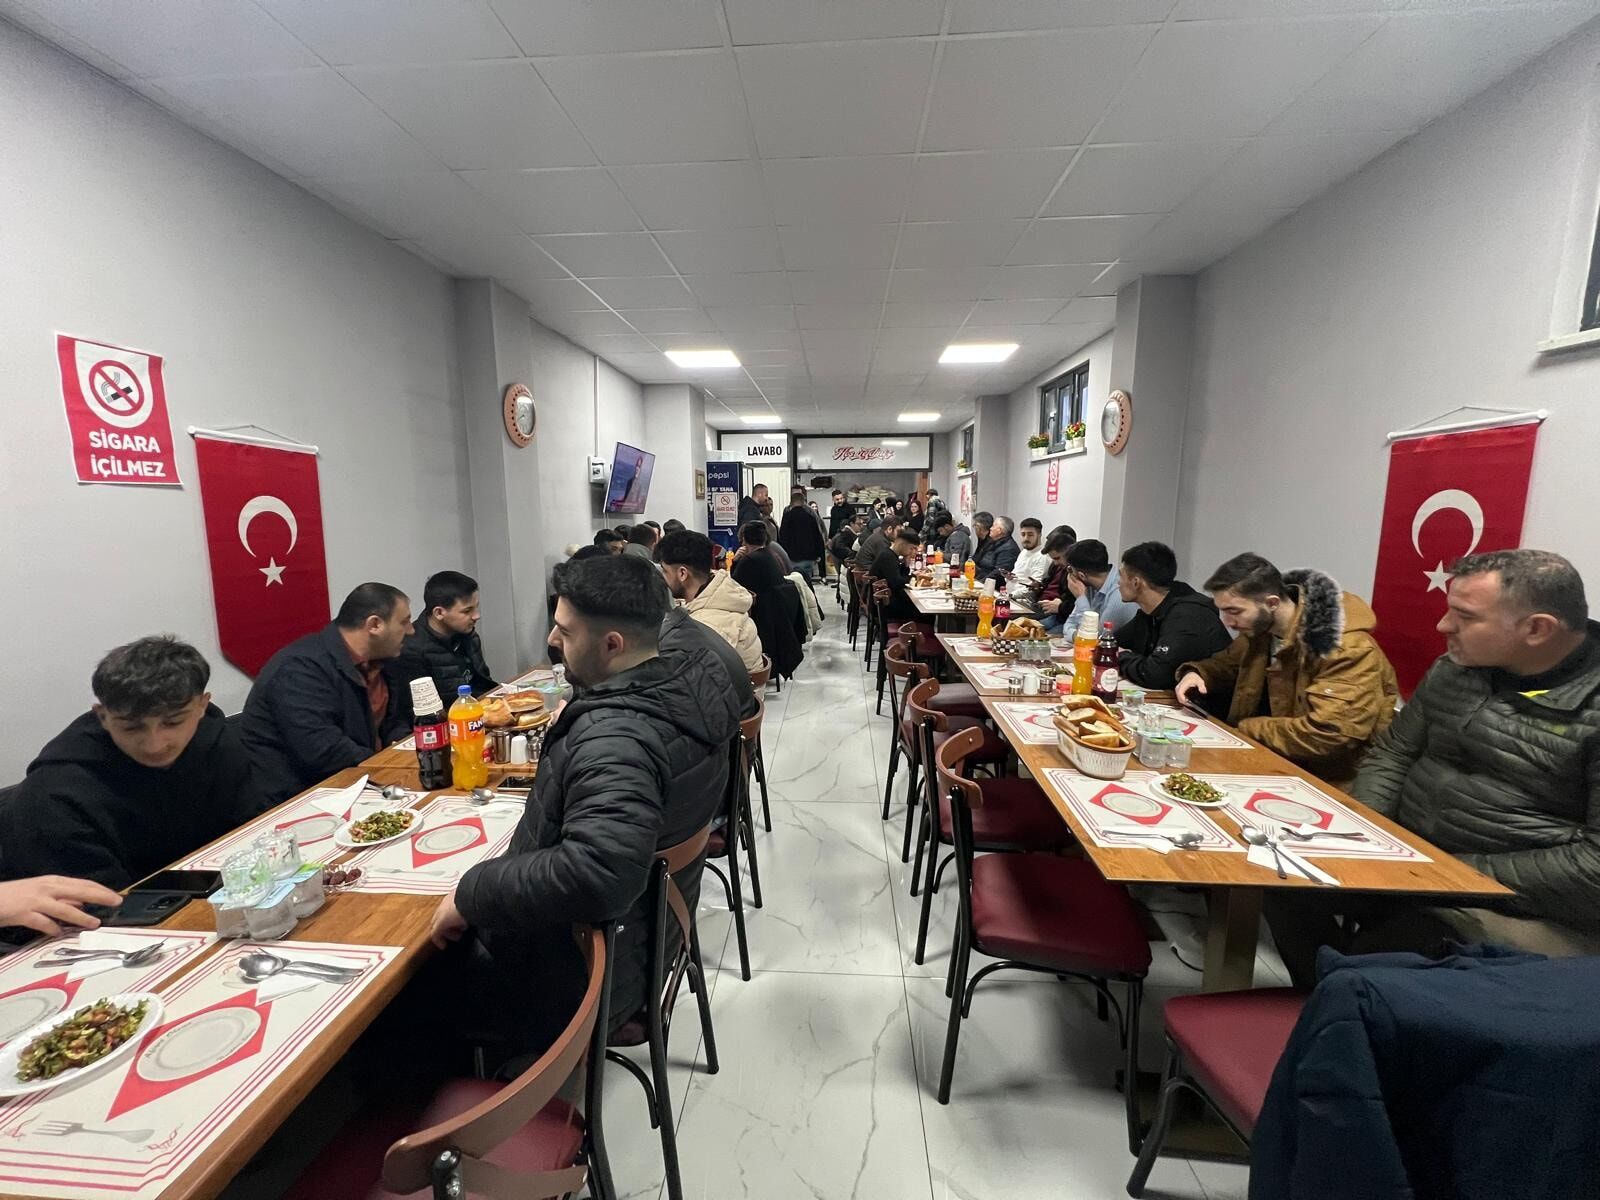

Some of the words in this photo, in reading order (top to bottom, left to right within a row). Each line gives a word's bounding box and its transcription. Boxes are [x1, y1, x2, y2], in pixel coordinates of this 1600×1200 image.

[88, 428, 161, 453] SİGARA
[747, 446, 782, 456] LAVABO
[90, 454, 166, 478] İÇİLMEZ
[708, 472, 730, 480] pepsi
